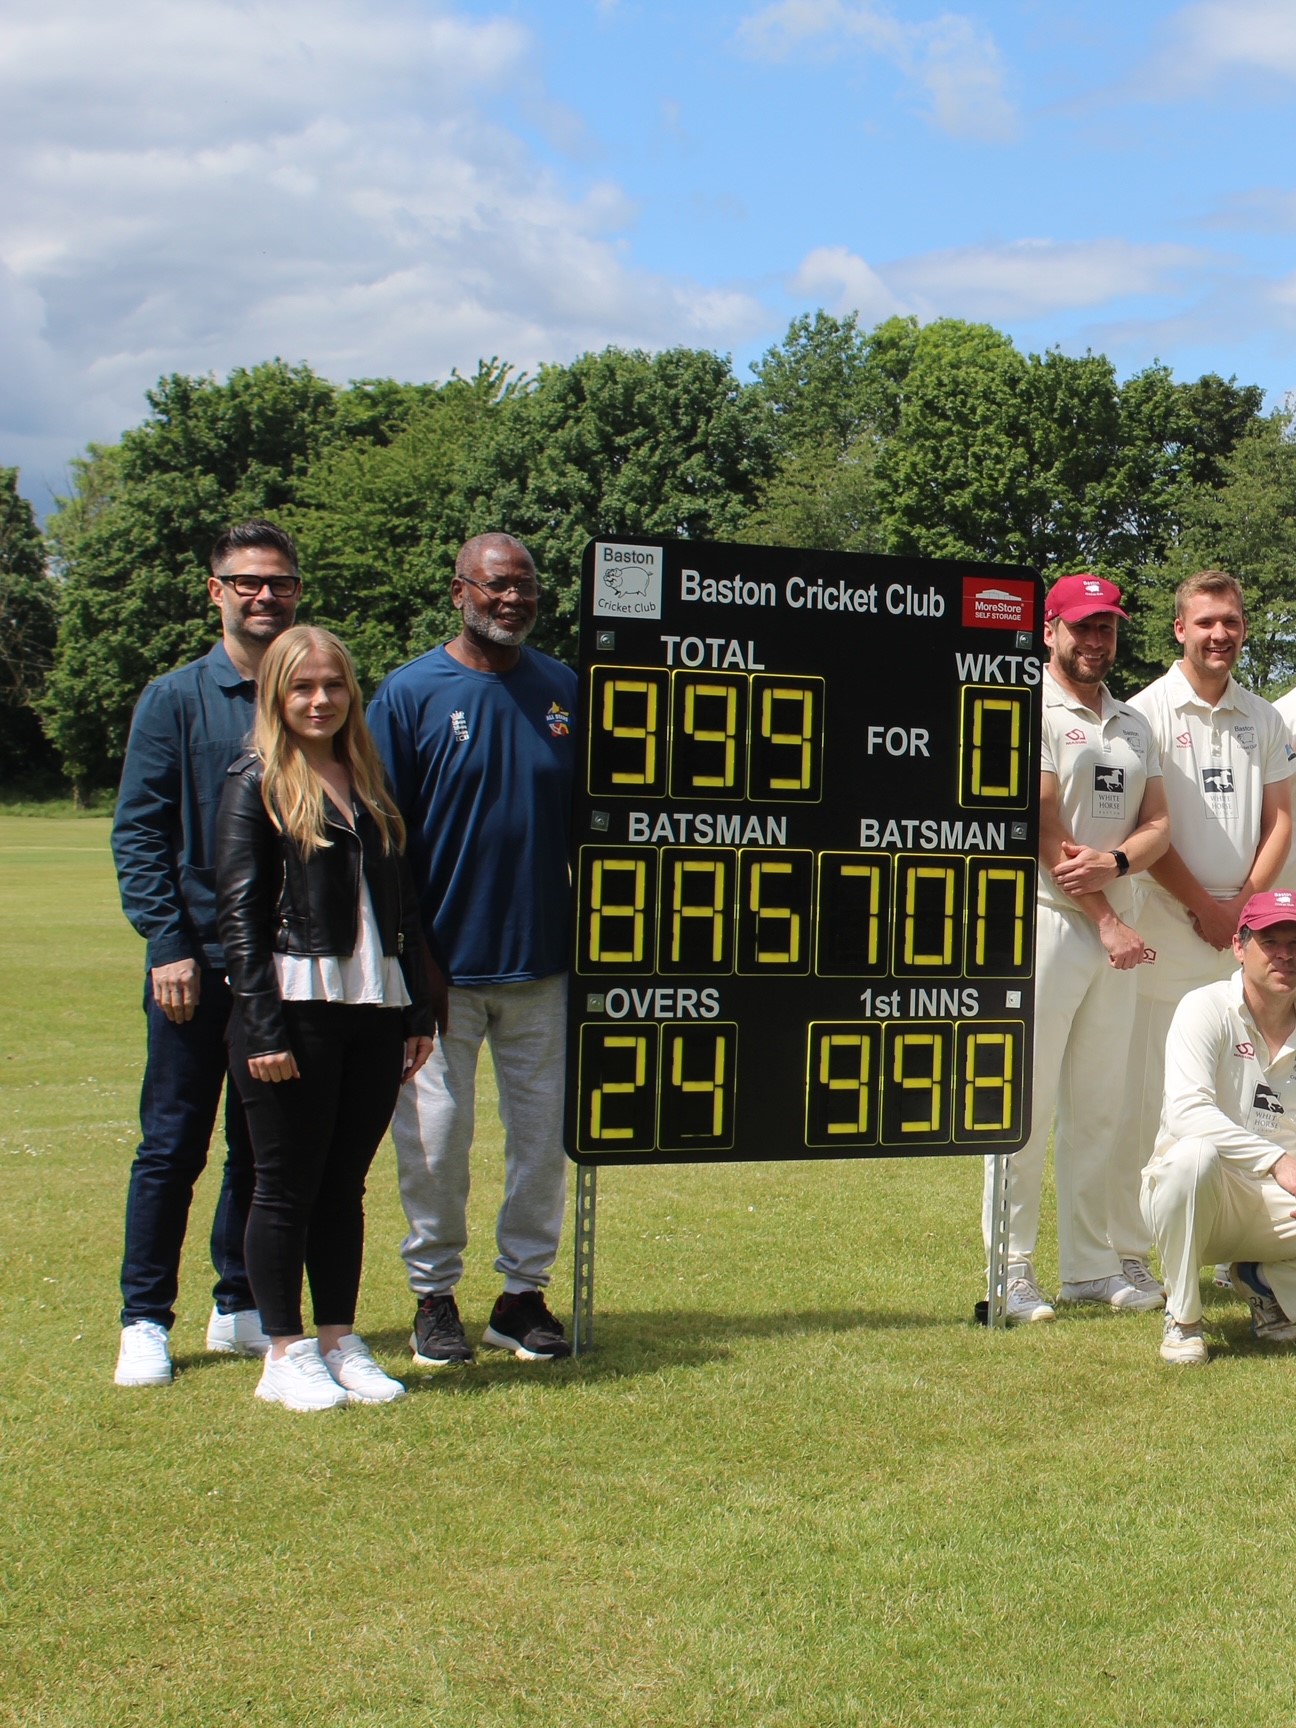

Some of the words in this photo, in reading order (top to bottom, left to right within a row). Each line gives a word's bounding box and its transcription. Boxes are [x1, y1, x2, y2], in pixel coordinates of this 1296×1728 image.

[603, 547, 654, 565] Baston
[598, 598, 632, 614] Cricket
[634, 601, 657, 613] Club
[680, 568, 776, 607] Baston
[785, 576, 878, 614] Cricket
[885, 583, 945, 618] Club
[975, 601, 1022, 613] MoreStore
[975, 611, 991, 619] SELF
[991, 612, 1022, 621] STORAGE
[660, 635, 765, 671] TOTAL
[955, 652, 1041, 685] WKTS
[603, 679, 813, 790] 999
[867, 726, 931, 758] FOR
[1099, 802, 1120, 810] HORSE
[628, 811, 787, 845] BATSMAN
[859, 818, 1005, 851] BATSMAN
[604, 987, 720, 1018] OVERS
[859, 988, 900, 1017] 1st
[909, 988, 980, 1017] INNS
[590, 1036, 725, 1139] 24
[819, 1033, 1014, 1134] 998
